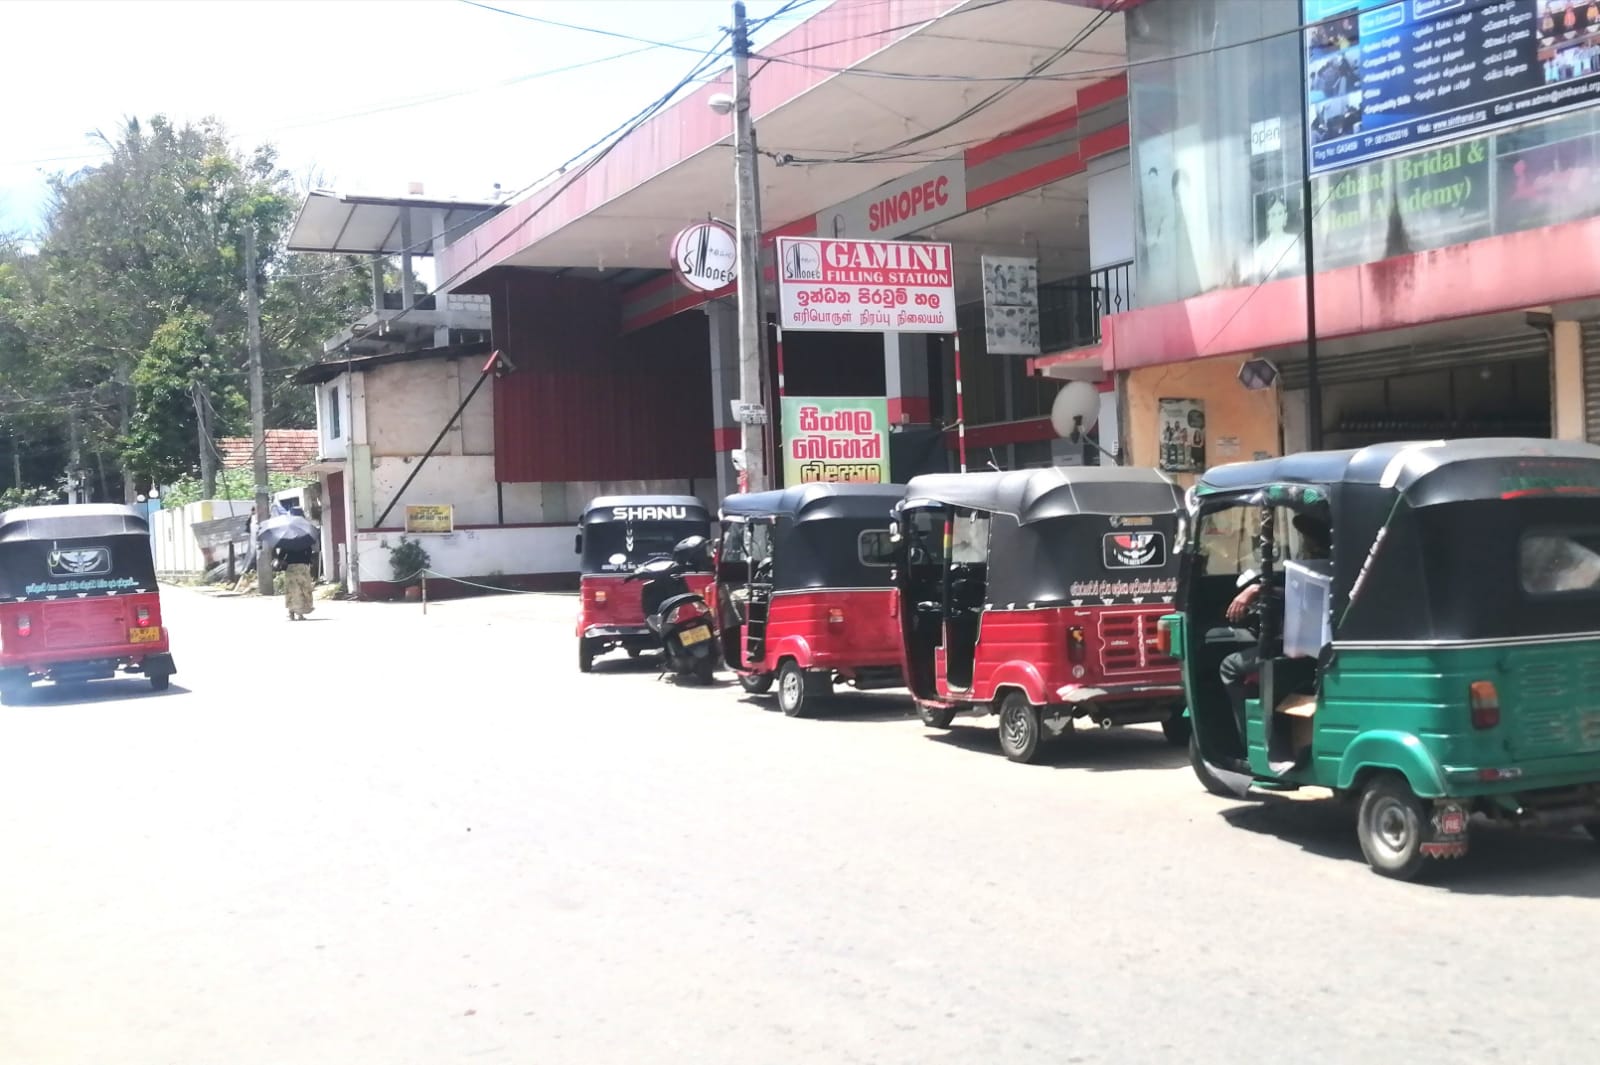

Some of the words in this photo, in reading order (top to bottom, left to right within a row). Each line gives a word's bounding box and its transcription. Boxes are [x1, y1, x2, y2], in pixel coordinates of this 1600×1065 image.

[1252, 126, 1280, 147] open
[1397, 147, 1461, 185] Bridal
[1467, 142, 1485, 164] &
[869, 175, 949, 232] SINOPEC
[825, 242, 948, 271] GAMINI
[826, 270, 884, 283] FILLING
[888, 271, 948, 285] STATION
[797, 288, 851, 307] ඉන්ධන
[858, 288, 908, 309] පිරවුම්
[914, 292, 941, 309] හල
[793, 307, 852, 325] எரிபொருள்
[859, 308, 891, 326] நிரப்பு
[897, 310, 944, 325] நிலையம்
[800, 407, 873, 435] සිංහල
[612, 506, 687, 521] SHANU
